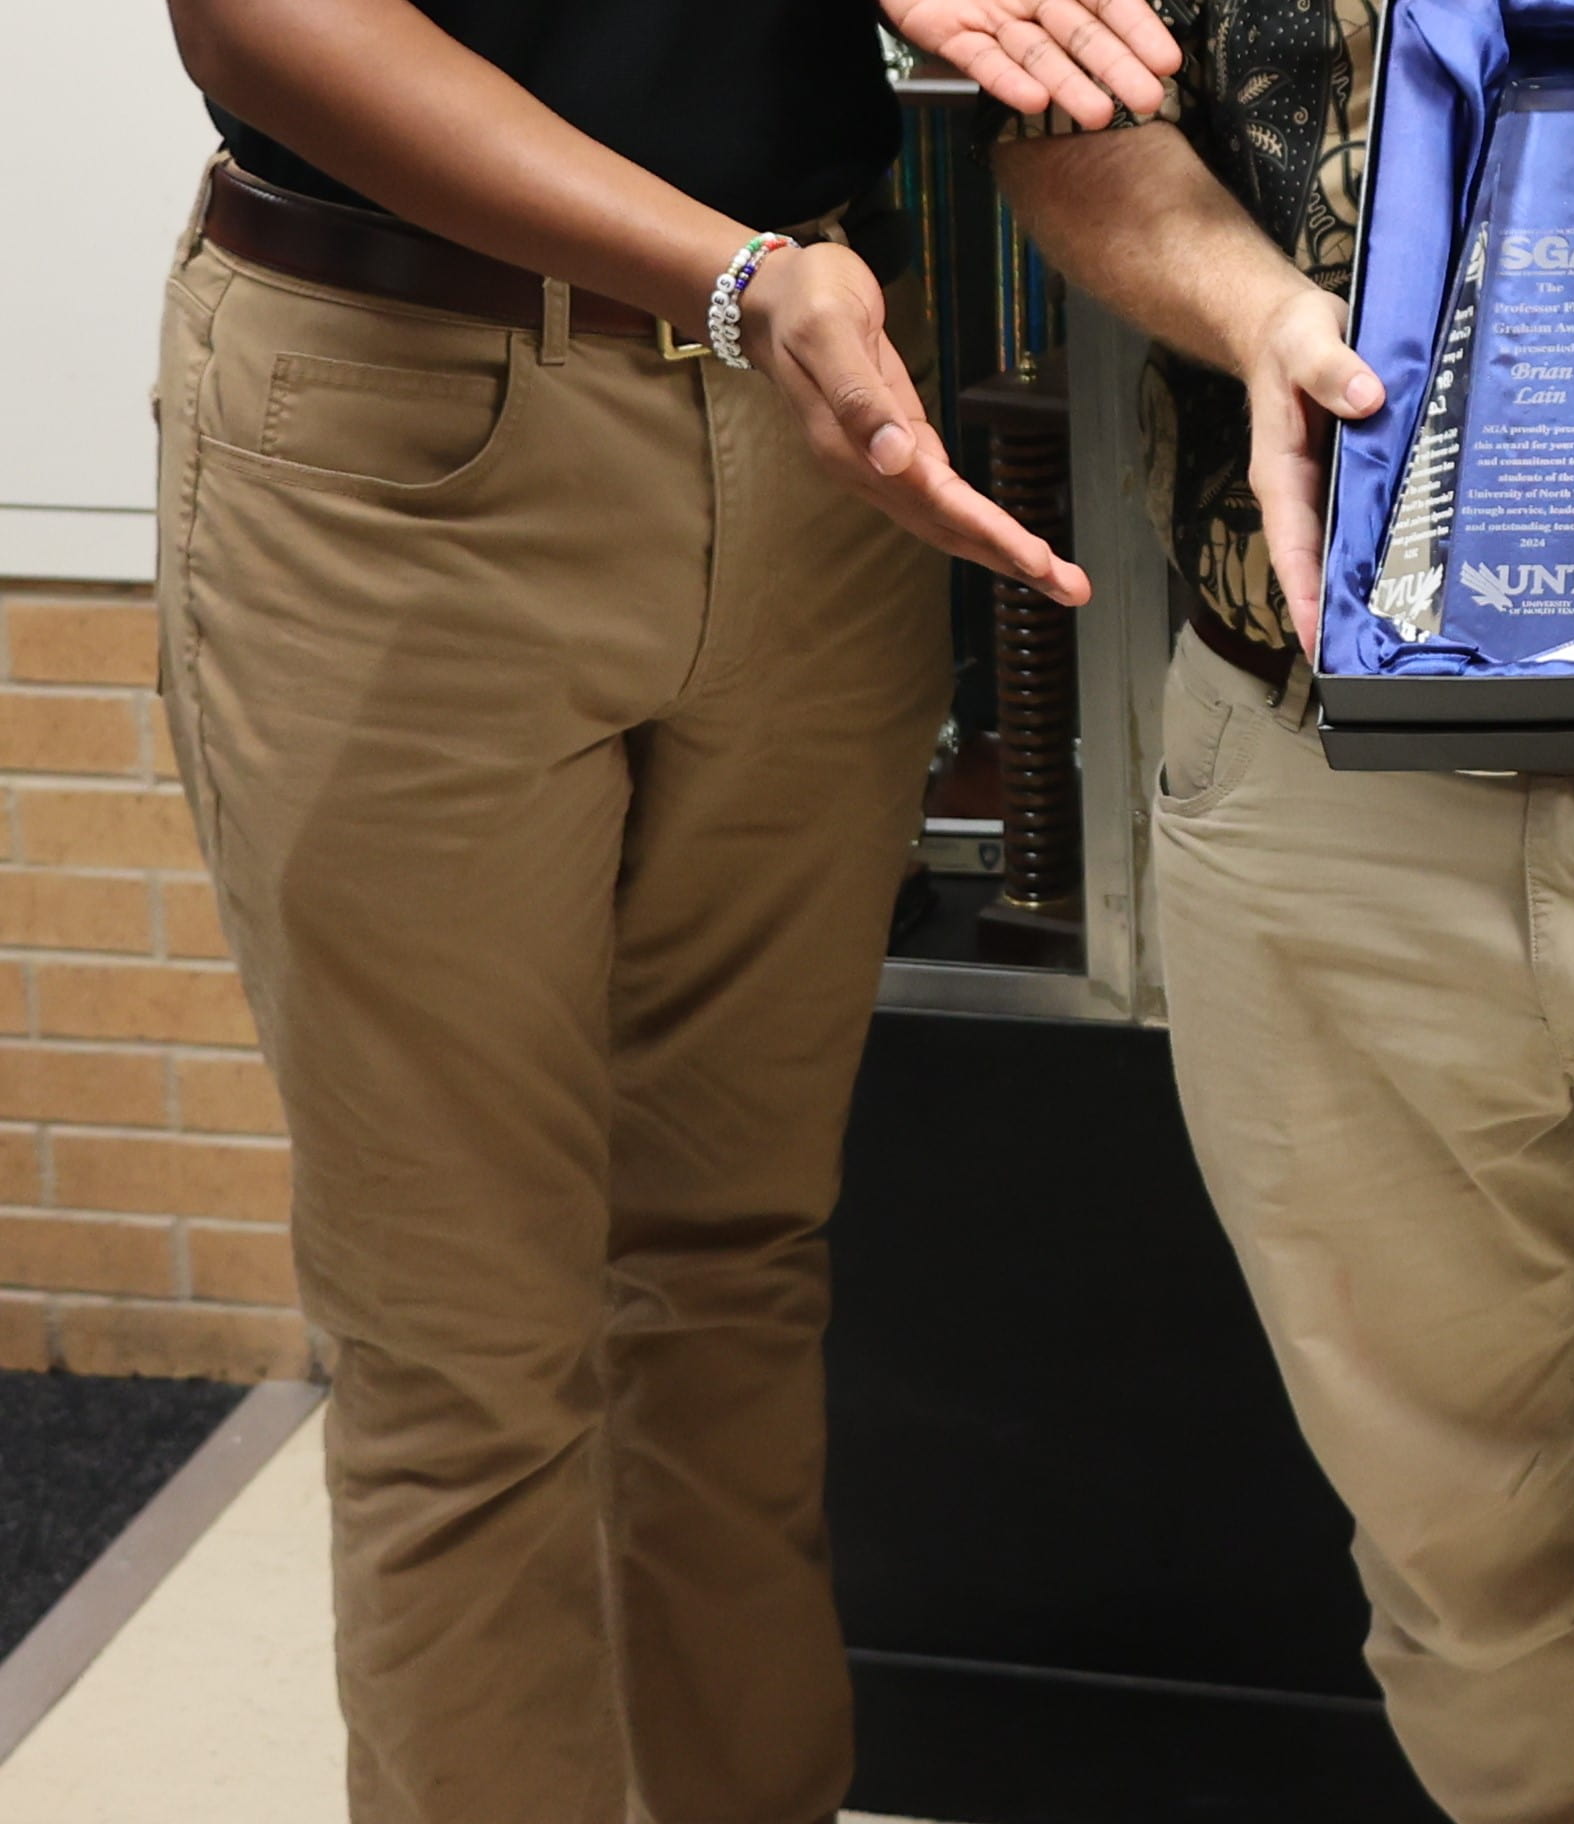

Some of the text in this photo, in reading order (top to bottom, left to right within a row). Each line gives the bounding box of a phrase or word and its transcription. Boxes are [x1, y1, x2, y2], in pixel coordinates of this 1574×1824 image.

[1536, 282, 1565, 293] The
[1495, 302, 1560, 314] Professor
[1494, 322, 1552, 334] Graham
[1514, 343, 1574, 356] presented
[1511, 361, 1574, 380] Brian
[1513, 386, 1567, 404] Lain
[1482, 425, 1508, 434] SGA
[1510, 424, 1551, 436] proudly
[1474, 441, 1493, 450] this
[1496, 441, 1529, 450] award
[1532, 441, 1548, 450] for
[1550, 443, 1574, 452] your
[1478, 457, 1498, 466] and
[1500, 456, 1567, 466] commitment
[1498, 473, 1543, 482] students
[1545, 473, 1556, 482] of
[1467, 488, 1523, 501] University
[1525, 488, 1537, 498] of
[1538, 488, 1571, 498] North
[1461, 505, 1505, 517] through
[1506, 506, 1547, 516] service,
[1465, 522, 1485, 532] and
[1488, 522, 1552, 533] outstanding
[1519, 538, 1546, 548] 2024
[1521, 600, 1573, 608] UNIVERSITY
[1523, 607, 1556, 615] NORTH
